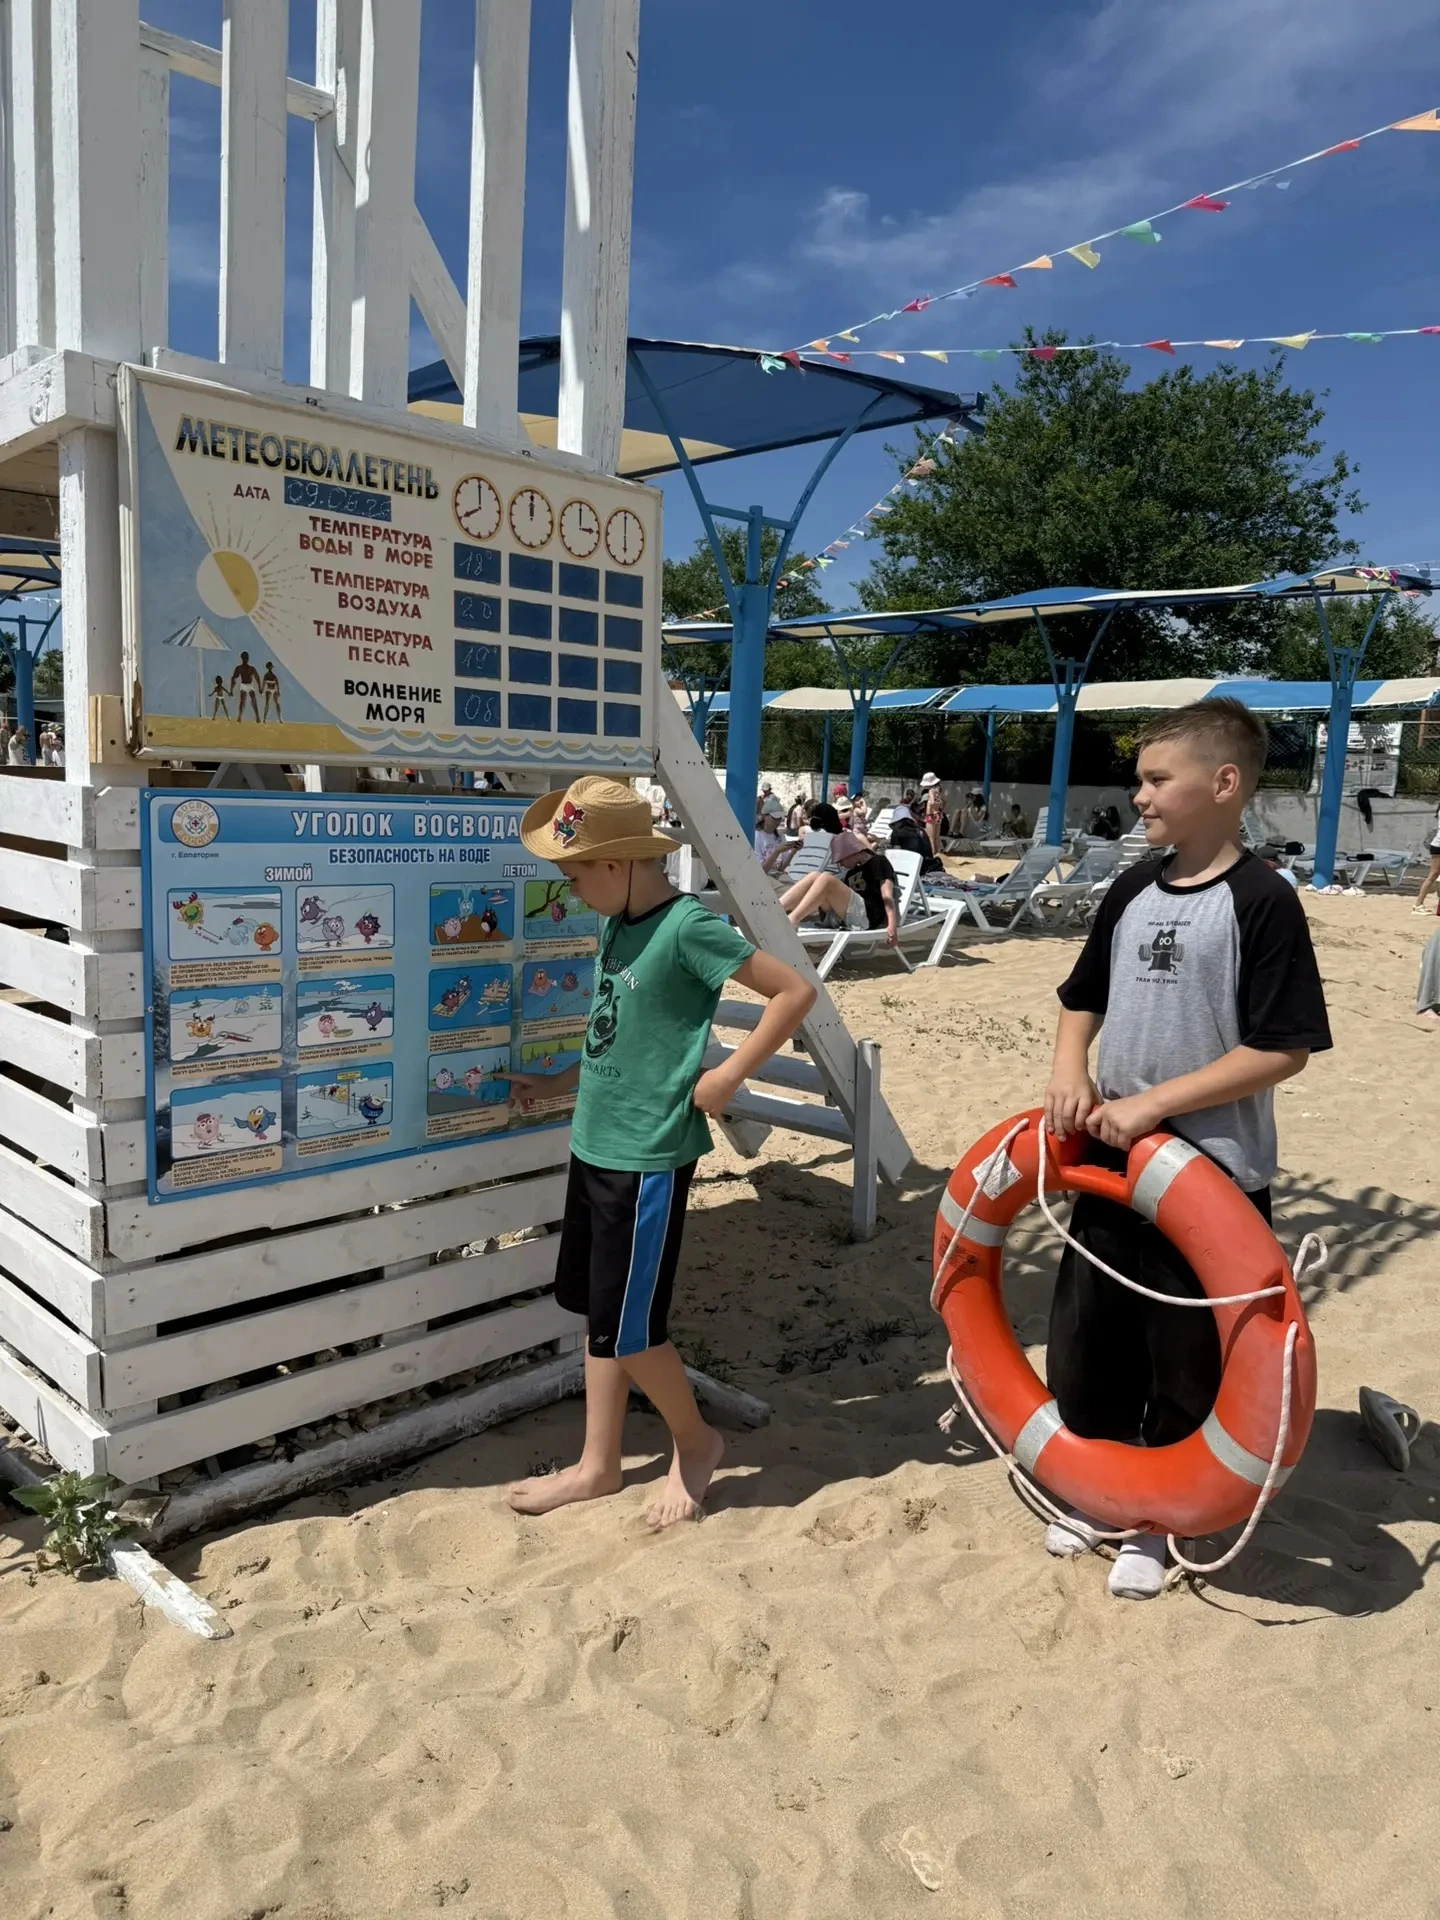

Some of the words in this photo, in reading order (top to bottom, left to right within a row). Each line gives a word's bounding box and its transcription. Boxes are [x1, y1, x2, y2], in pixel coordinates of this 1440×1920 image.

[175, 415, 439, 499] МЕТЕОБЮЛЛЕТЕНЬ
[233, 484, 270, 501] ДАТА
[309, 515, 432, 551] ТЕМПЕРАТУРА
[299, 533, 353, 556] ВОДЫ
[364, 544, 374, 559] В
[385, 547, 433, 569] МОРЕ
[310, 567, 430, 600] ТЕМПЕРАТУРА
[338, 592, 422, 619] ВОЗДУХА
[313, 620, 433, 651] ТЕМПЕРАТУРА
[348, 645, 410, 667] ПЕСКА
[344, 679, 442, 704] ВОЛНЕНИЕ
[366, 703, 425, 724] МОРЯ
[292, 811, 393, 837] УГОЛОК
[413, 814, 521, 839] ВОСВОДА
[329, 848, 434, 864] БЕЗОПАСНОСТЬ
[438, 848, 455, 863] НА
[459, 848, 491, 863] ВОДЕ
[265, 864, 312, 882] ЗИМОЙ
[502, 864, 537, 878] ЛЕТОМ
[599, 957, 640, 991] THERIN
[582, 1060, 621, 1079] GWARTS
